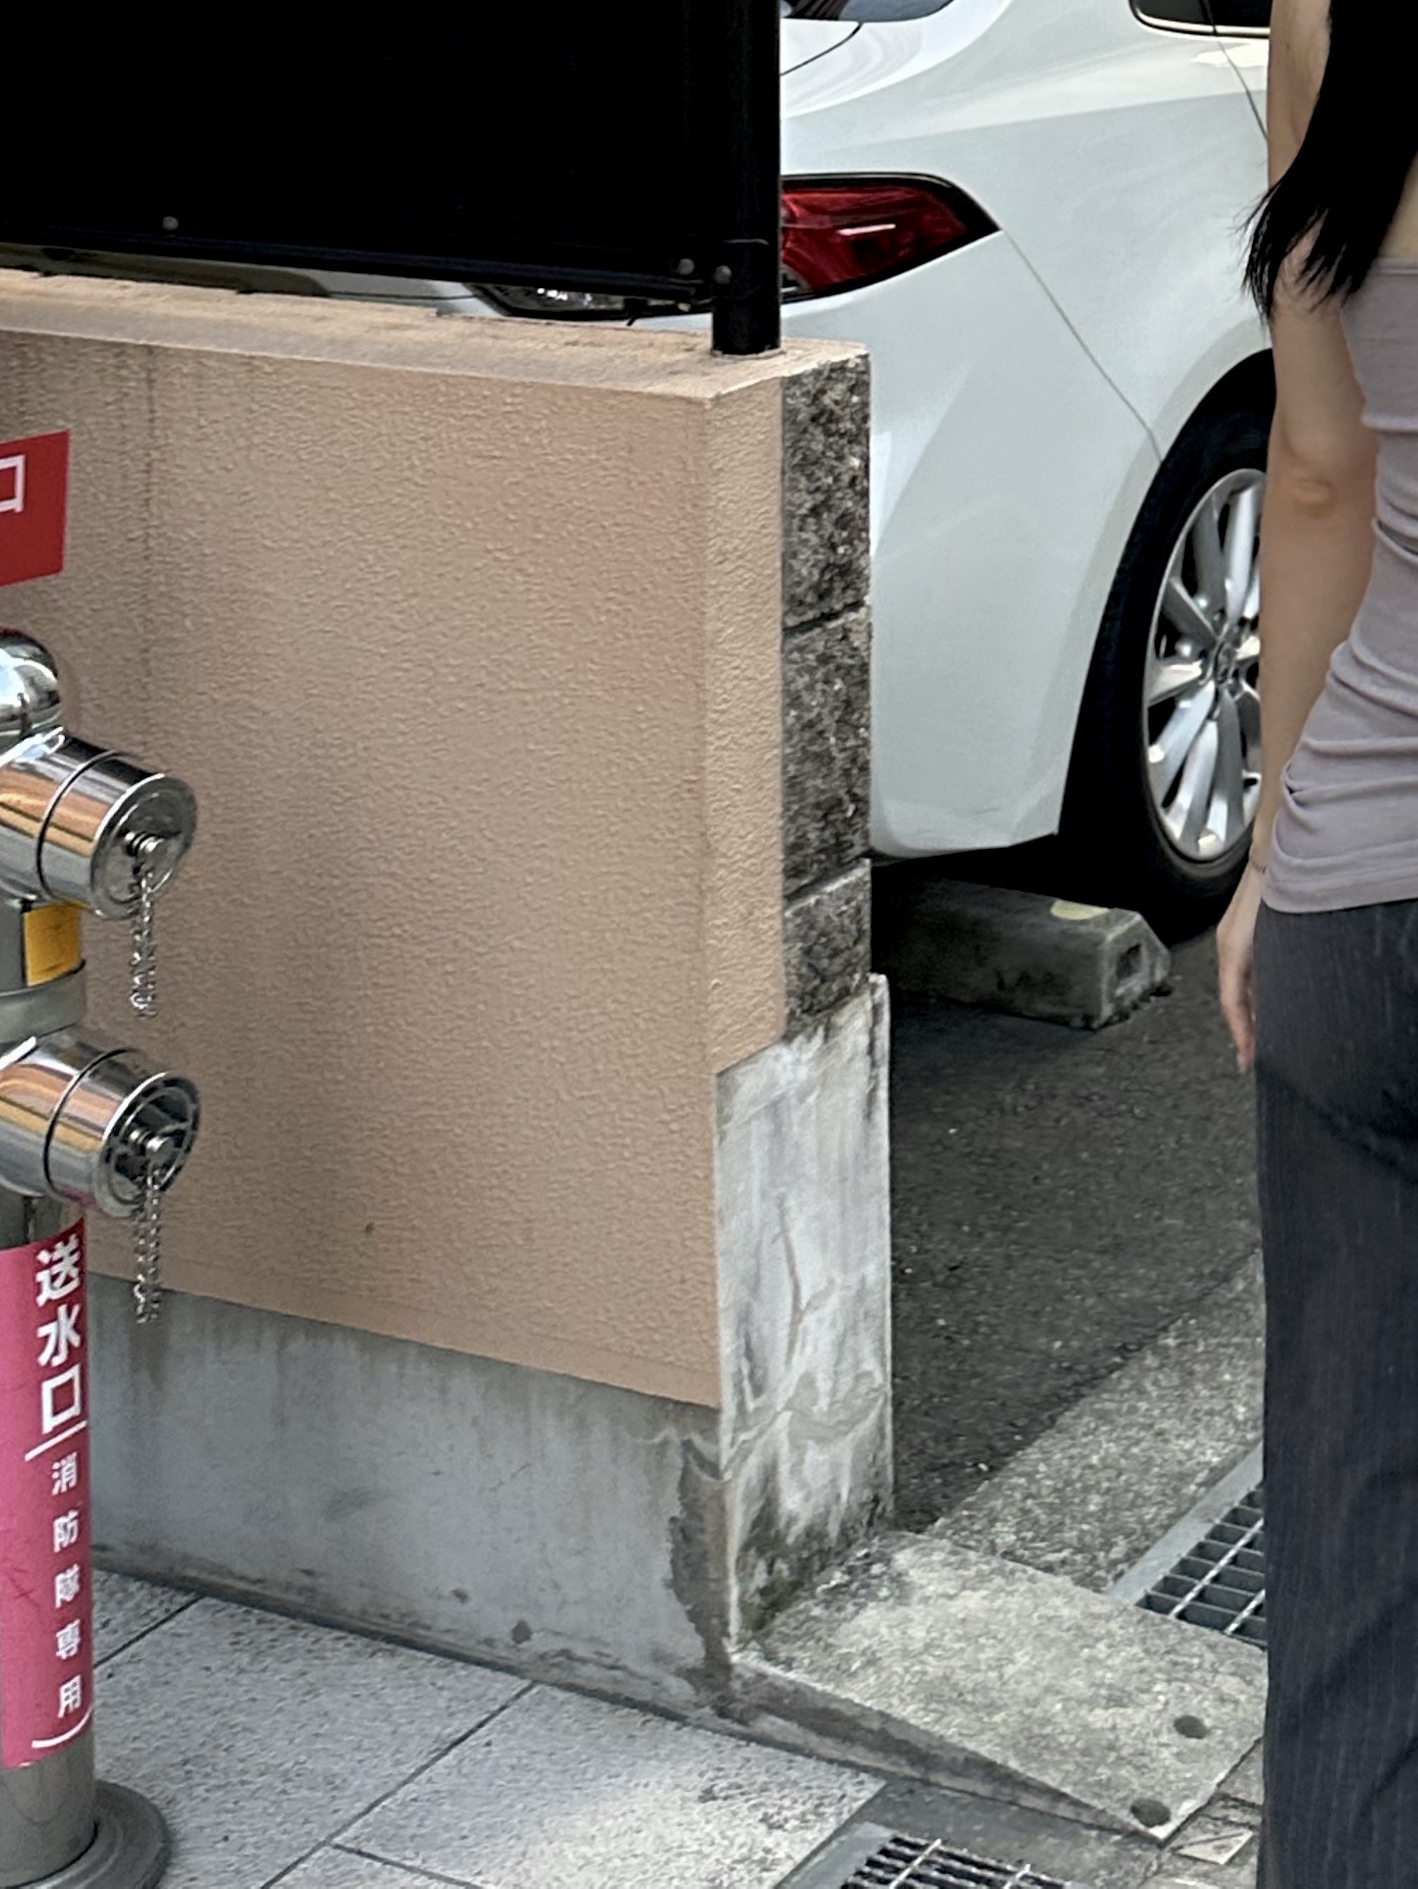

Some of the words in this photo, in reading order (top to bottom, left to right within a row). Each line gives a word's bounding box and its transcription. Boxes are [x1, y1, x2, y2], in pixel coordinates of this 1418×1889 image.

[36, 1232, 84, 1435] 送水口
[52, 1450, 84, 1719] 消防隊専用
